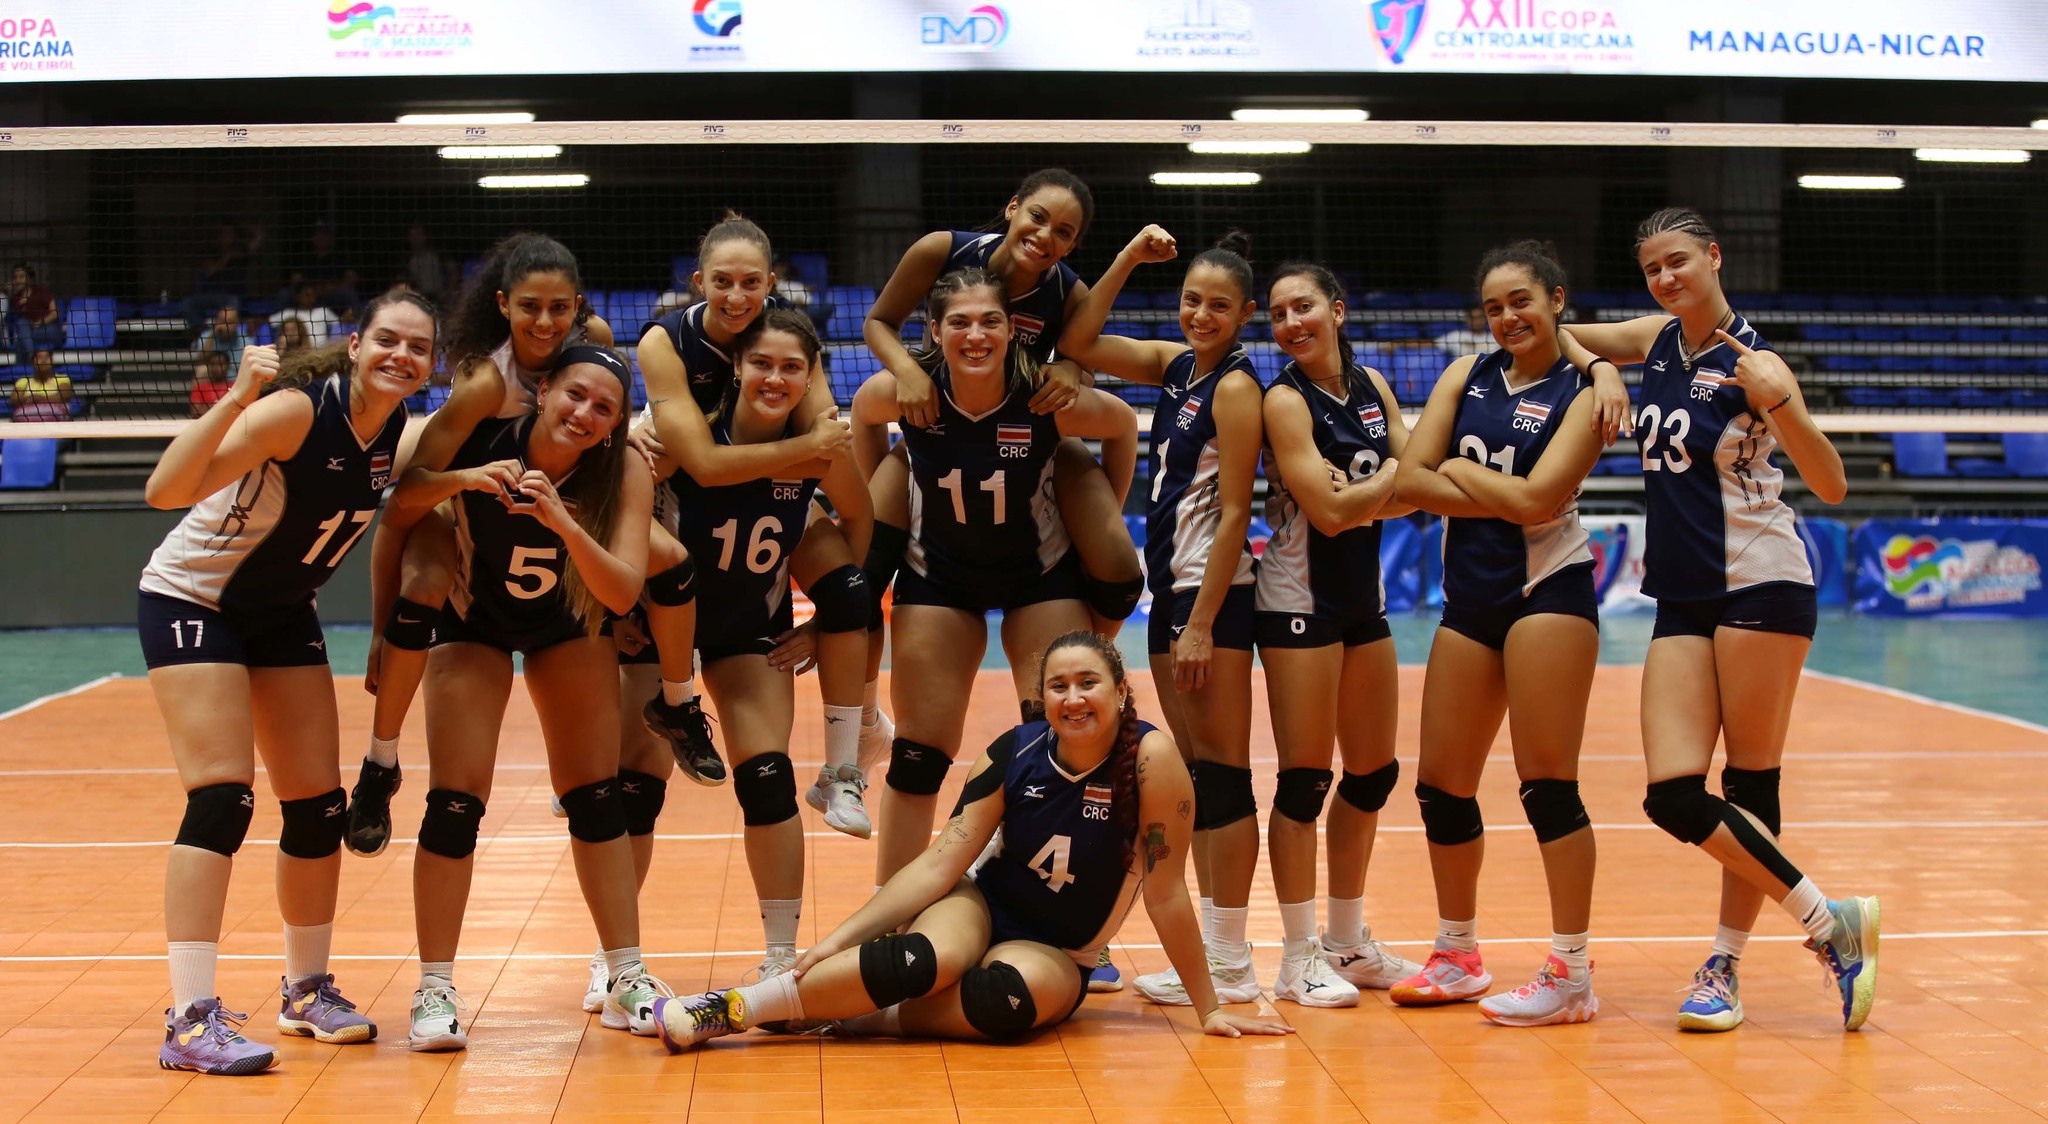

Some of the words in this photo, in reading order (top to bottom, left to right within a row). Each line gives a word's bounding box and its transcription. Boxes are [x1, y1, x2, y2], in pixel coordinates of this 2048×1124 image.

[1456, 0, 1535, 29] XXII
[1541, 10, 1618, 30] COPA
[1434, 31, 1635, 48] CENTROAMERICANA
[1689, 30, 1985, 57] MANAGUA-NICAR
[11, 60, 76, 71] VOLEIBOL
[1690, 386, 1713, 402] CRC
[1175, 413, 1192, 431] CRC
[1369, 424, 1387, 440] CRC
[1512, 418, 1541, 434] CRC
[1638, 404, 1692, 474] 23
[1000, 446, 1029, 459] CRC
[773, 487, 800, 500] CRC
[938, 468, 1006, 526] 11
[301, 508, 377, 568] 17
[712, 515, 784, 574] 16
[504, 545, 557, 599] 5
[171, 620, 204, 649] 17
[1082, 805, 1109, 821] CRC
[1027, 834, 1075, 893] 4
